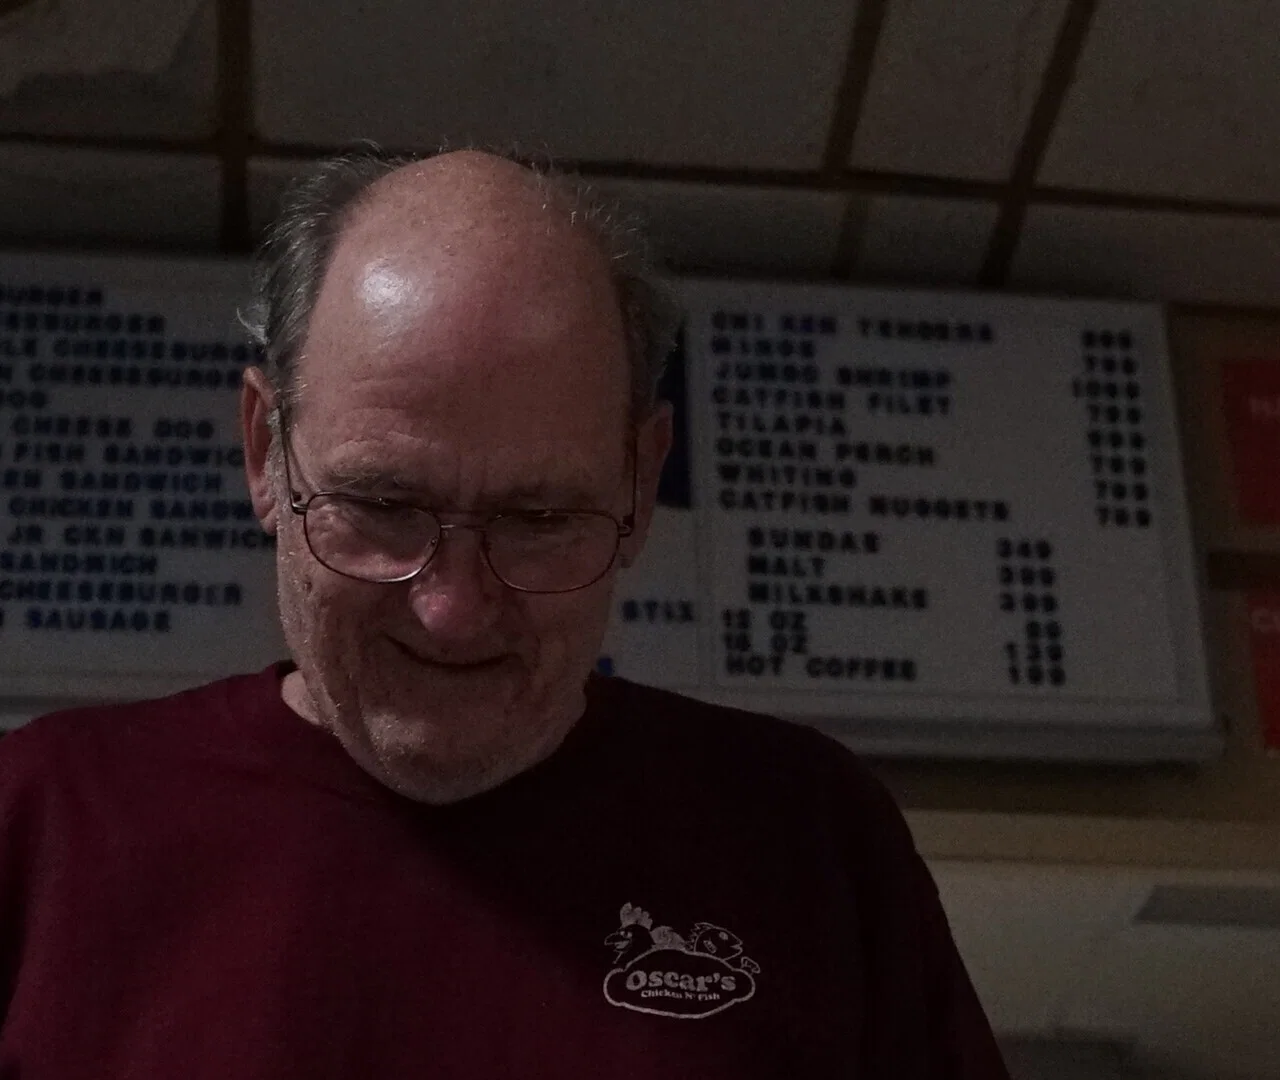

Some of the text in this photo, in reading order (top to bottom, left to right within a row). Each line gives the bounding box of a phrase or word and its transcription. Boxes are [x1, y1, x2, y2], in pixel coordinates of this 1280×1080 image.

[857, 317, 993, 342] TENDERS
[711, 336, 815, 358] WINGS
[715, 363, 819, 383] JUMBO
[837, 367, 951, 388] SHRIMP
[712, 387, 846, 409] CATFISH
[867, 392, 951, 414] FILET
[13, 415, 133, 438] CHEESE
[154, 419, 215, 440] DOG
[717, 412, 846, 435] TILAPIA
[13, 442, 86, 464] FISH
[104, 443, 245, 467] SANDWIC
[715, 437, 817, 460] OCEAN
[835, 442, 934, 465] PERCH
[60, 470, 223, 493] SANDWICH
[717, 464, 856, 489] WHITING
[8, 498, 135, 519] CHICKEN
[718, 490, 850, 512] CATFISH
[869, 496, 1009, 521] NUGGETS
[7, 525, 43, 545] JR
[64, 526, 124, 546] CKN
[747, 527, 880, 554] SUNDAE
[0, 551, 157, 574] SANDWICH
[747, 555, 826, 578] MALT
[747, 582, 929, 610] MILKSHAKE
[25, 609, 171, 633] SAUSAGE
[769, 611, 807, 632] OZ
[770, 634, 808, 654] OZ
[725, 655, 785, 676] HOT
[806, 658, 916, 680] COFFEE
[625, 970, 737, 992] Oscar's
[640, 989, 683, 999] Chicken
[697, 992, 721, 1001] Fish
